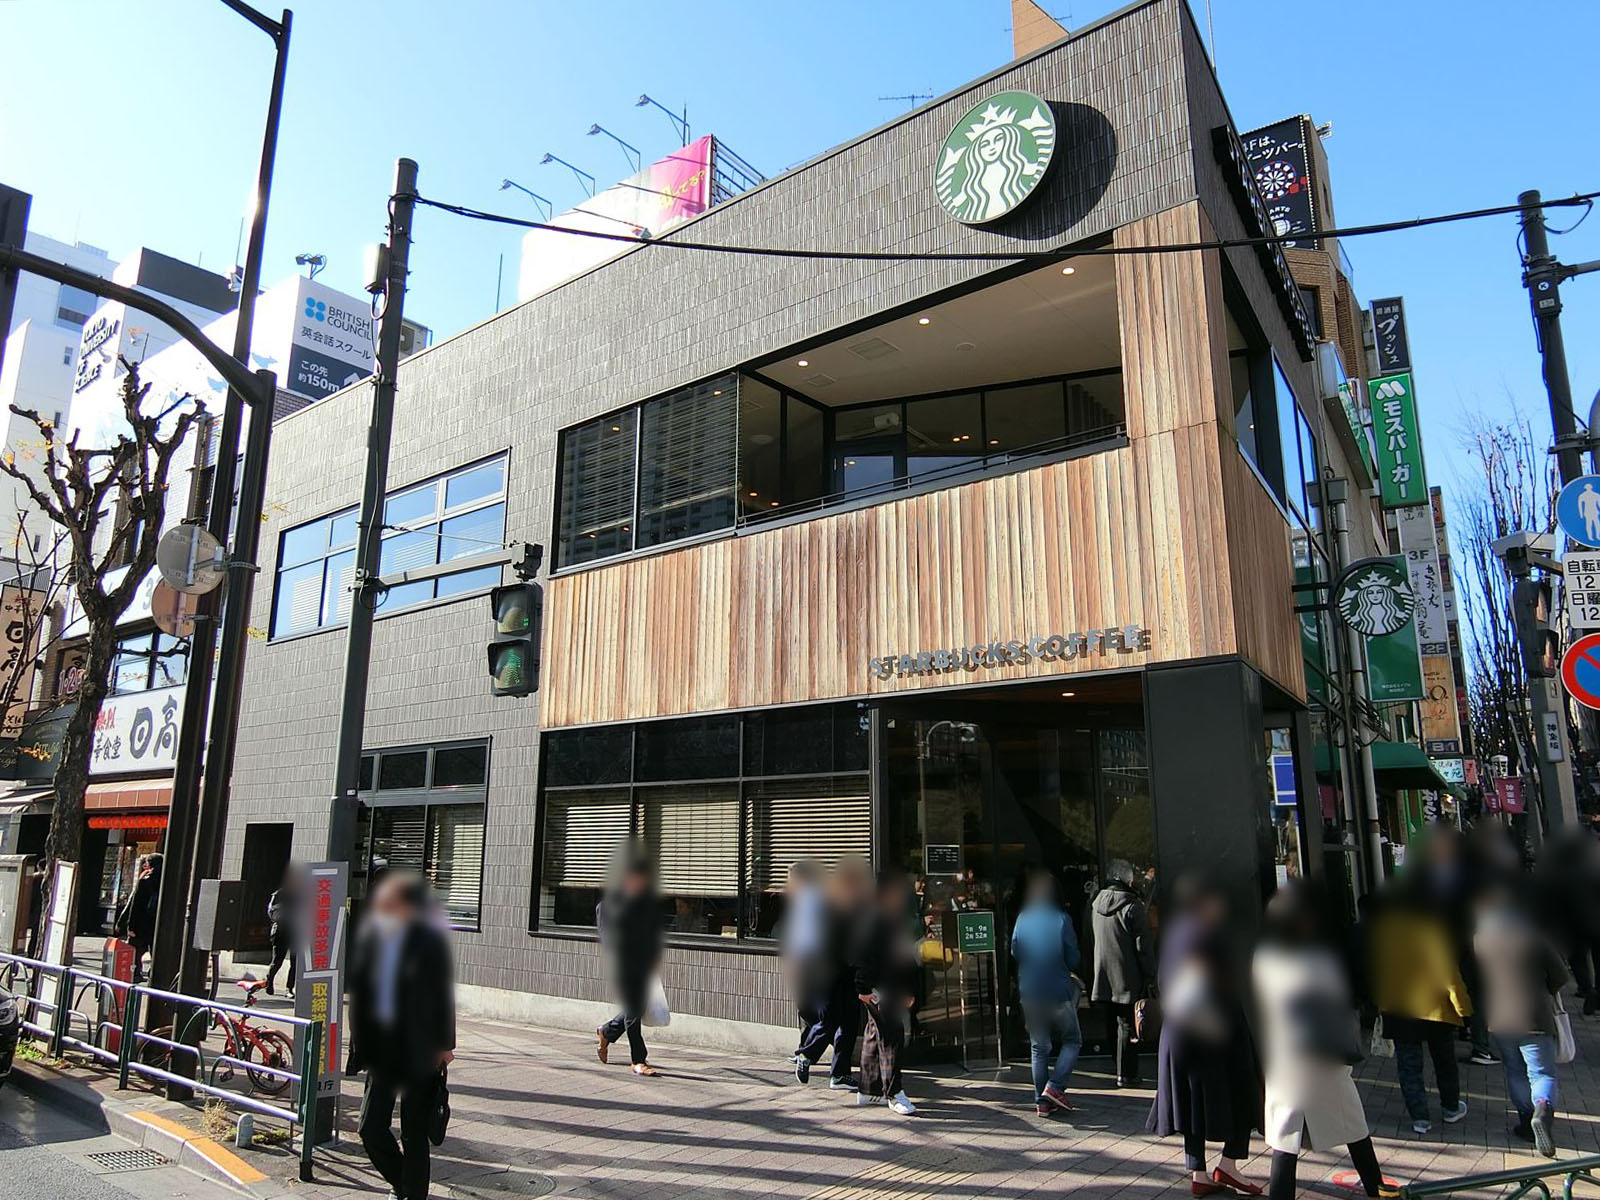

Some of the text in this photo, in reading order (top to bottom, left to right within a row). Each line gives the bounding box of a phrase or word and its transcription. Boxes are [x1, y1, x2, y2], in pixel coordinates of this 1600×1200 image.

[329, 306, 370, 329] BRITISH
[327, 316, 372, 340] COUNCIL
[301, 326, 371, 359] 英会話スクール
[1377, 314, 1400, 364] プッシュ
[301, 361, 328, 377] この先
[298, 373, 340, 392] 約150m
[1383, 400, 1410, 498] モスバーガー
[1408, 550, 1429, 560] 3F
[1568, 560, 1600, 573] 自転
[1576, 575, 1595, 589] 12
[1581, 607, 1600, 621] 12
[869, 624, 1141, 677] STARBUCKS COFFEE
[1426, 644, 1446, 655] 2F
